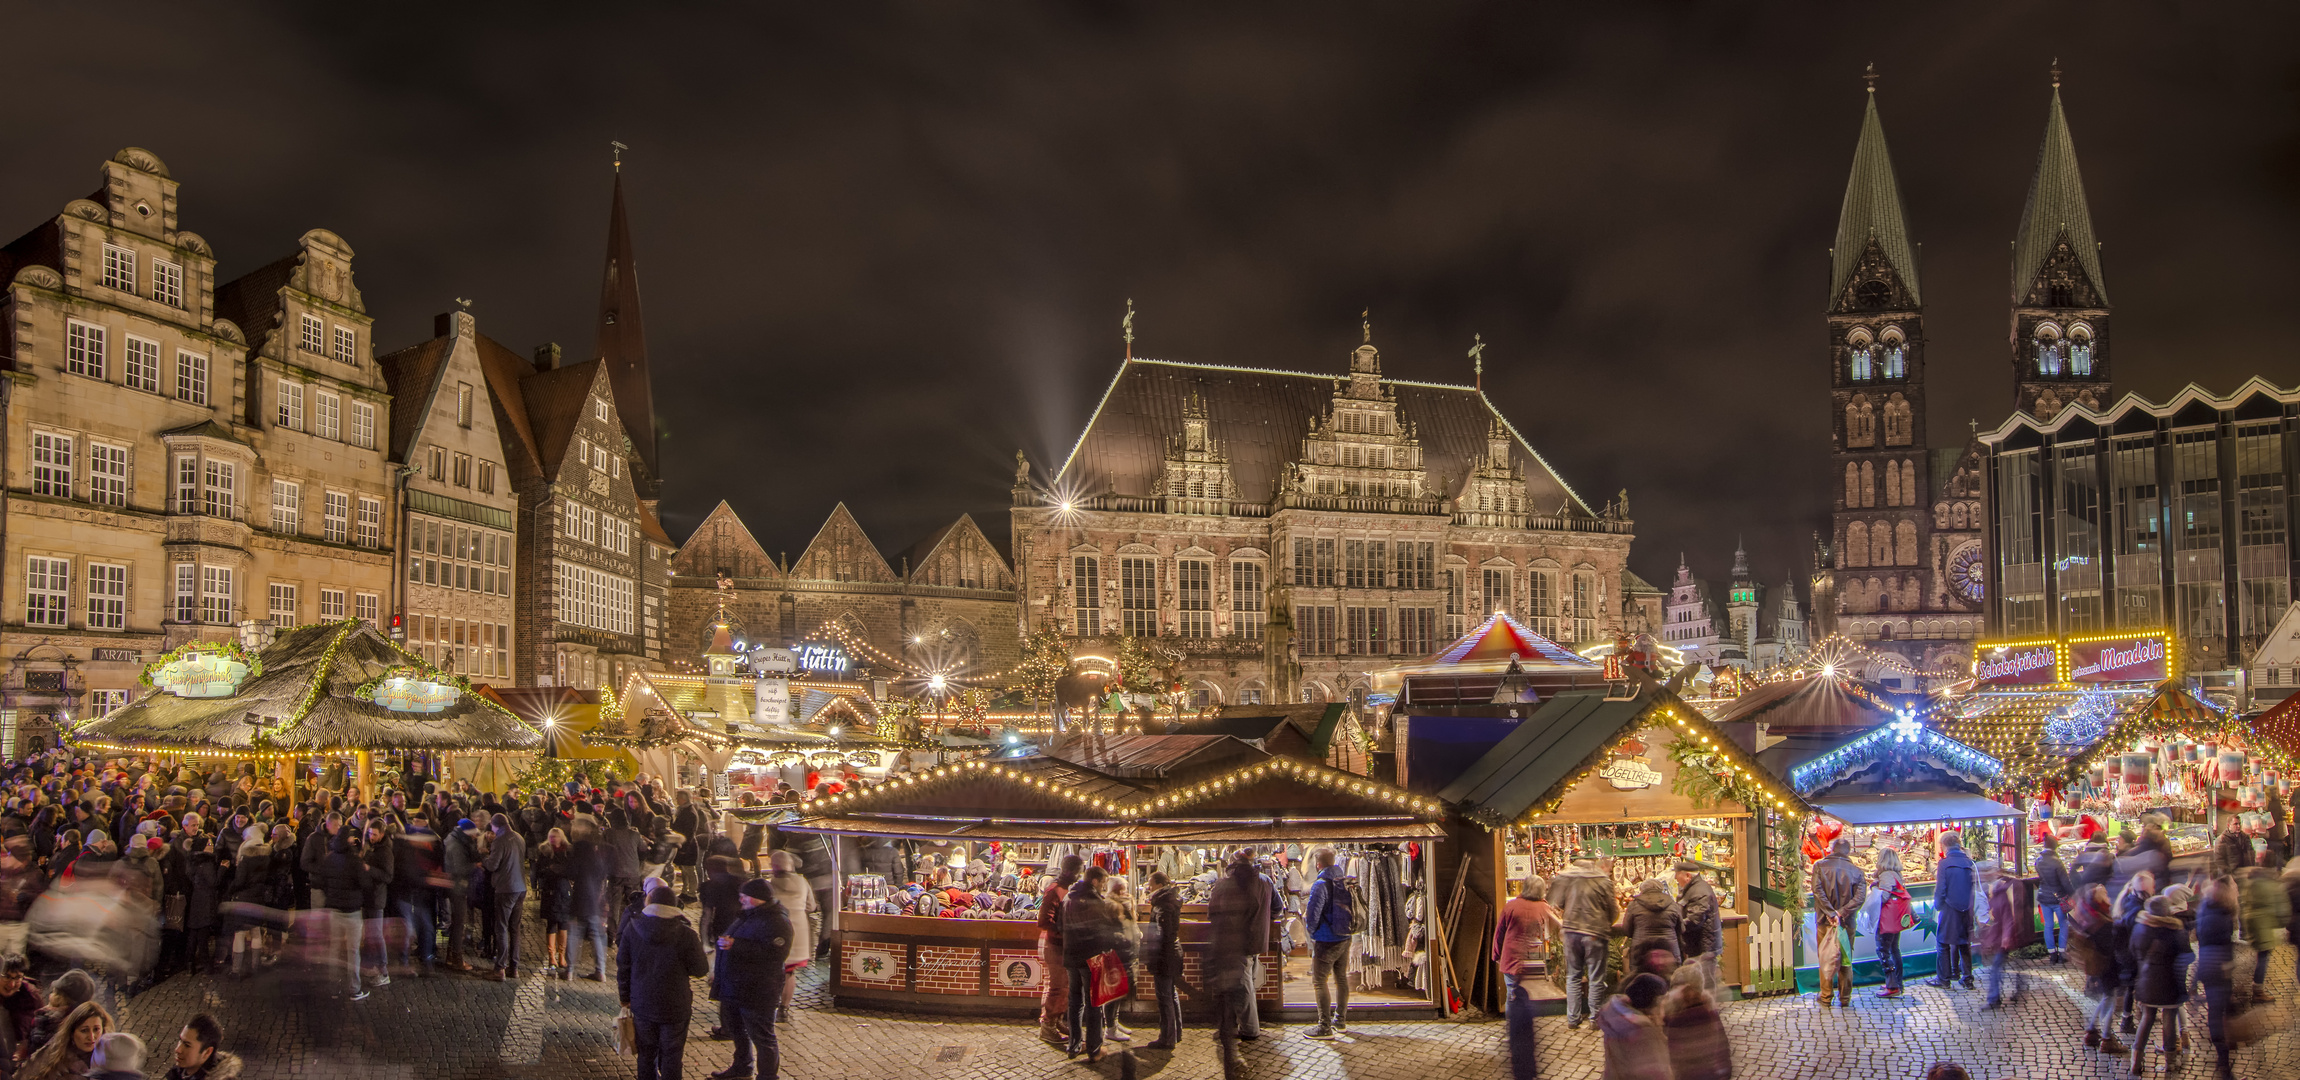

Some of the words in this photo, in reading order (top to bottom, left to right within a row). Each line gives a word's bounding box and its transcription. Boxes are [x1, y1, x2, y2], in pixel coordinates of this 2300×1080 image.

[100, 649, 135, 661] ÄRZTE
[1979, 646, 2055, 680] Schokofrüchte
[2071, 662, 2100, 680] gebrannte
[2100, 638, 2164, 671] Mandeln
[163, 660, 235, 695] Feuerzangenbowle
[1601, 766, 1660, 783] VOGELTREFF
